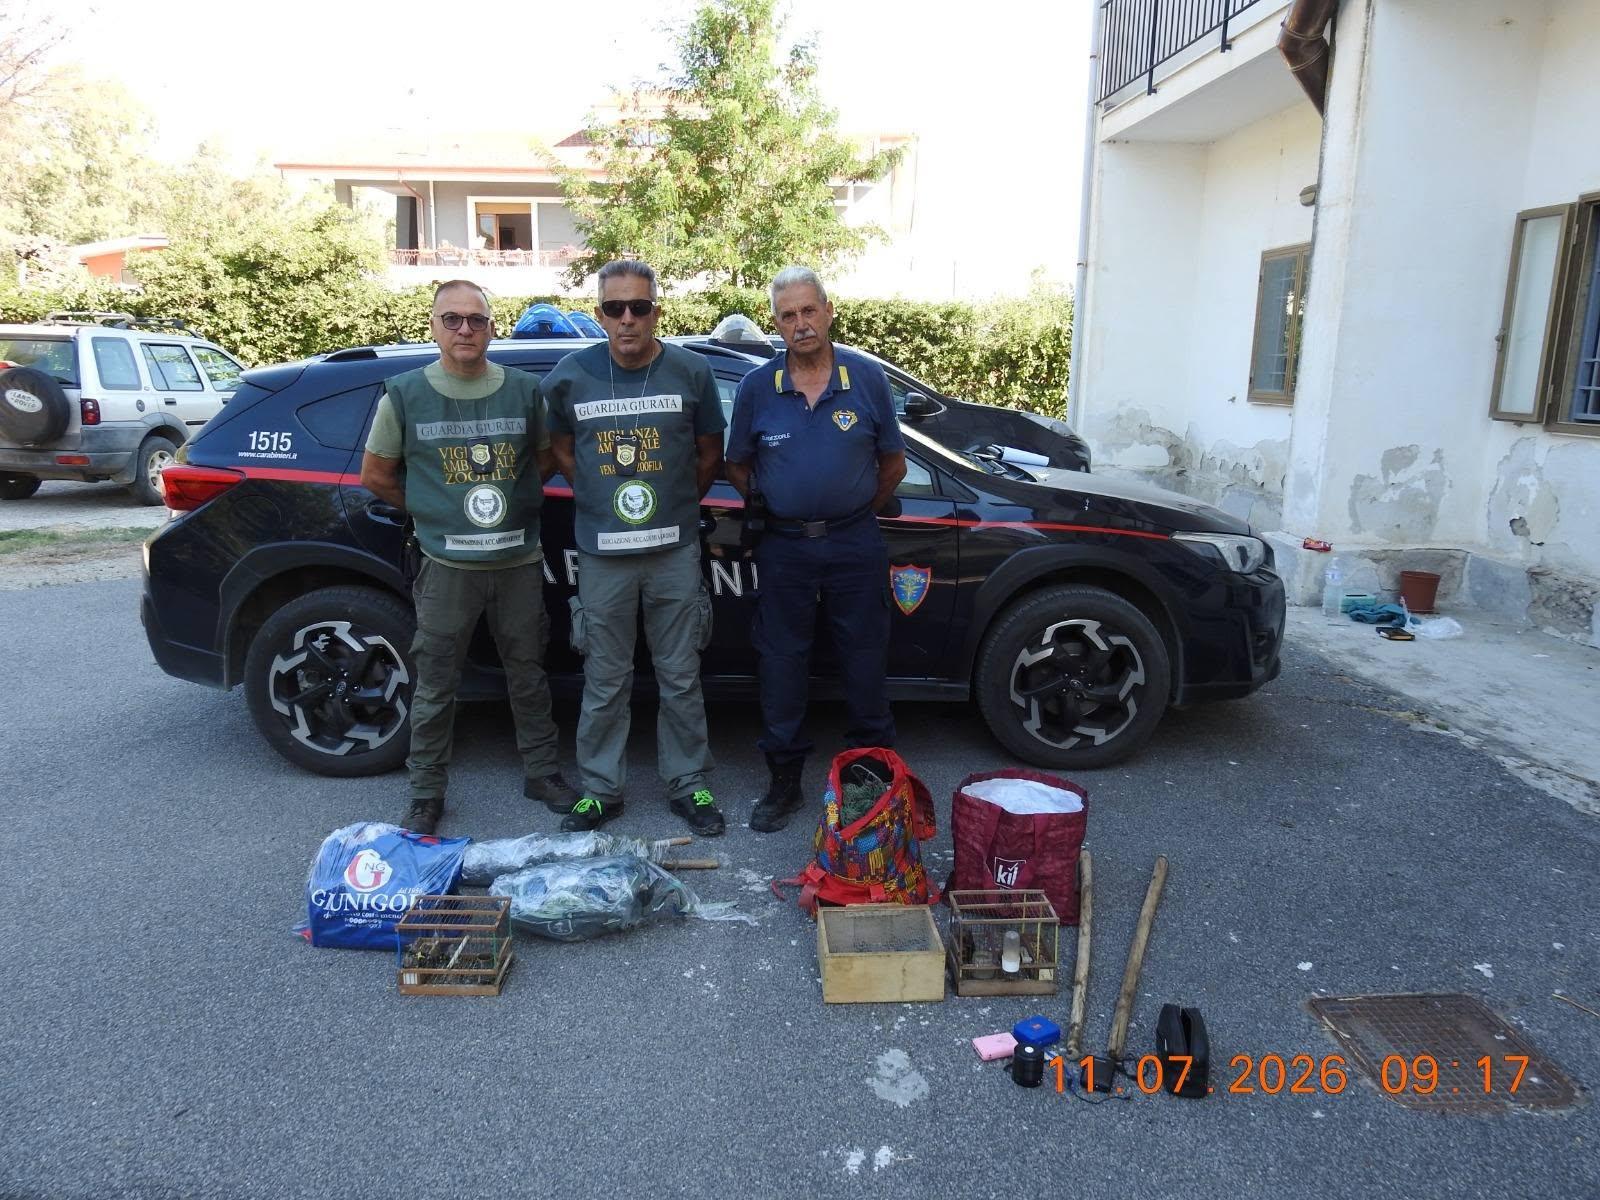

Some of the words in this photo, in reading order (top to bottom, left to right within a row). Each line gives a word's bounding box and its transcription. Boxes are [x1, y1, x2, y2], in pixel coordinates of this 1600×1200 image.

[579, 403, 627, 417] GUARDIA
[630, 398, 678, 411] GIURATA
[421, 423, 474, 437] GUARDIA
[476, 421, 524, 434] GIURATA
[597, 427, 660, 443] VIGNZA
[248, 431, 292, 451] 1515
[238, 451, 298, 460] www.carabinieri.it
[438, 442, 516, 460] VIGINZA
[443, 455, 516, 473] AMBALE
[364, 861, 386, 872] NG
